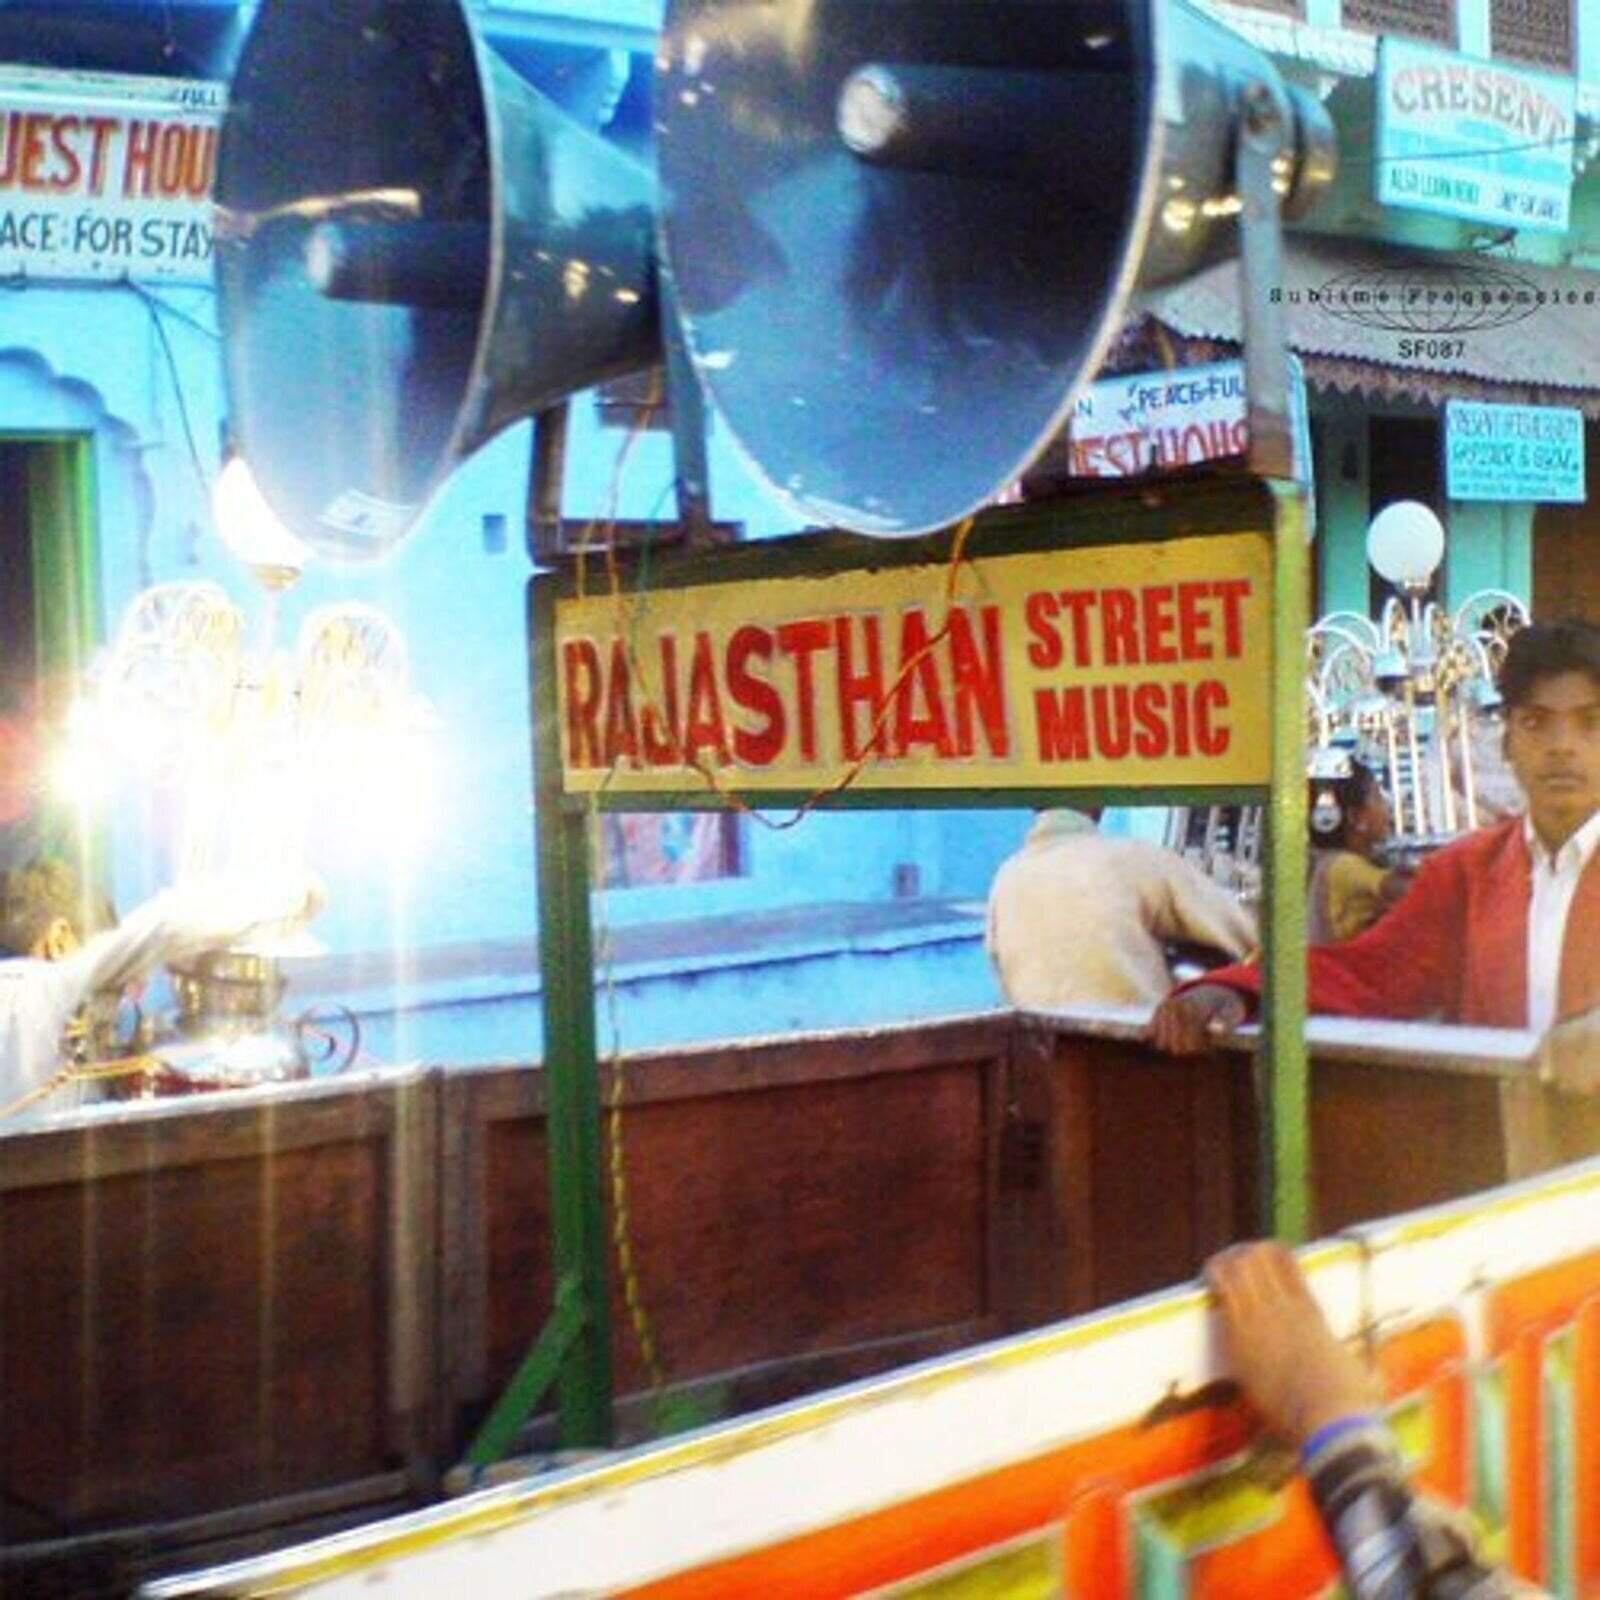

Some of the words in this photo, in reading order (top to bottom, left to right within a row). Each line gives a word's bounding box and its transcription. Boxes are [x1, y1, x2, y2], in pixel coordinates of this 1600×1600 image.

[1026, 578, 1252, 668] STREET
[561, 604, 1009, 768] RAJASTHAN
[1034, 680, 1231, 763] MUSIC
